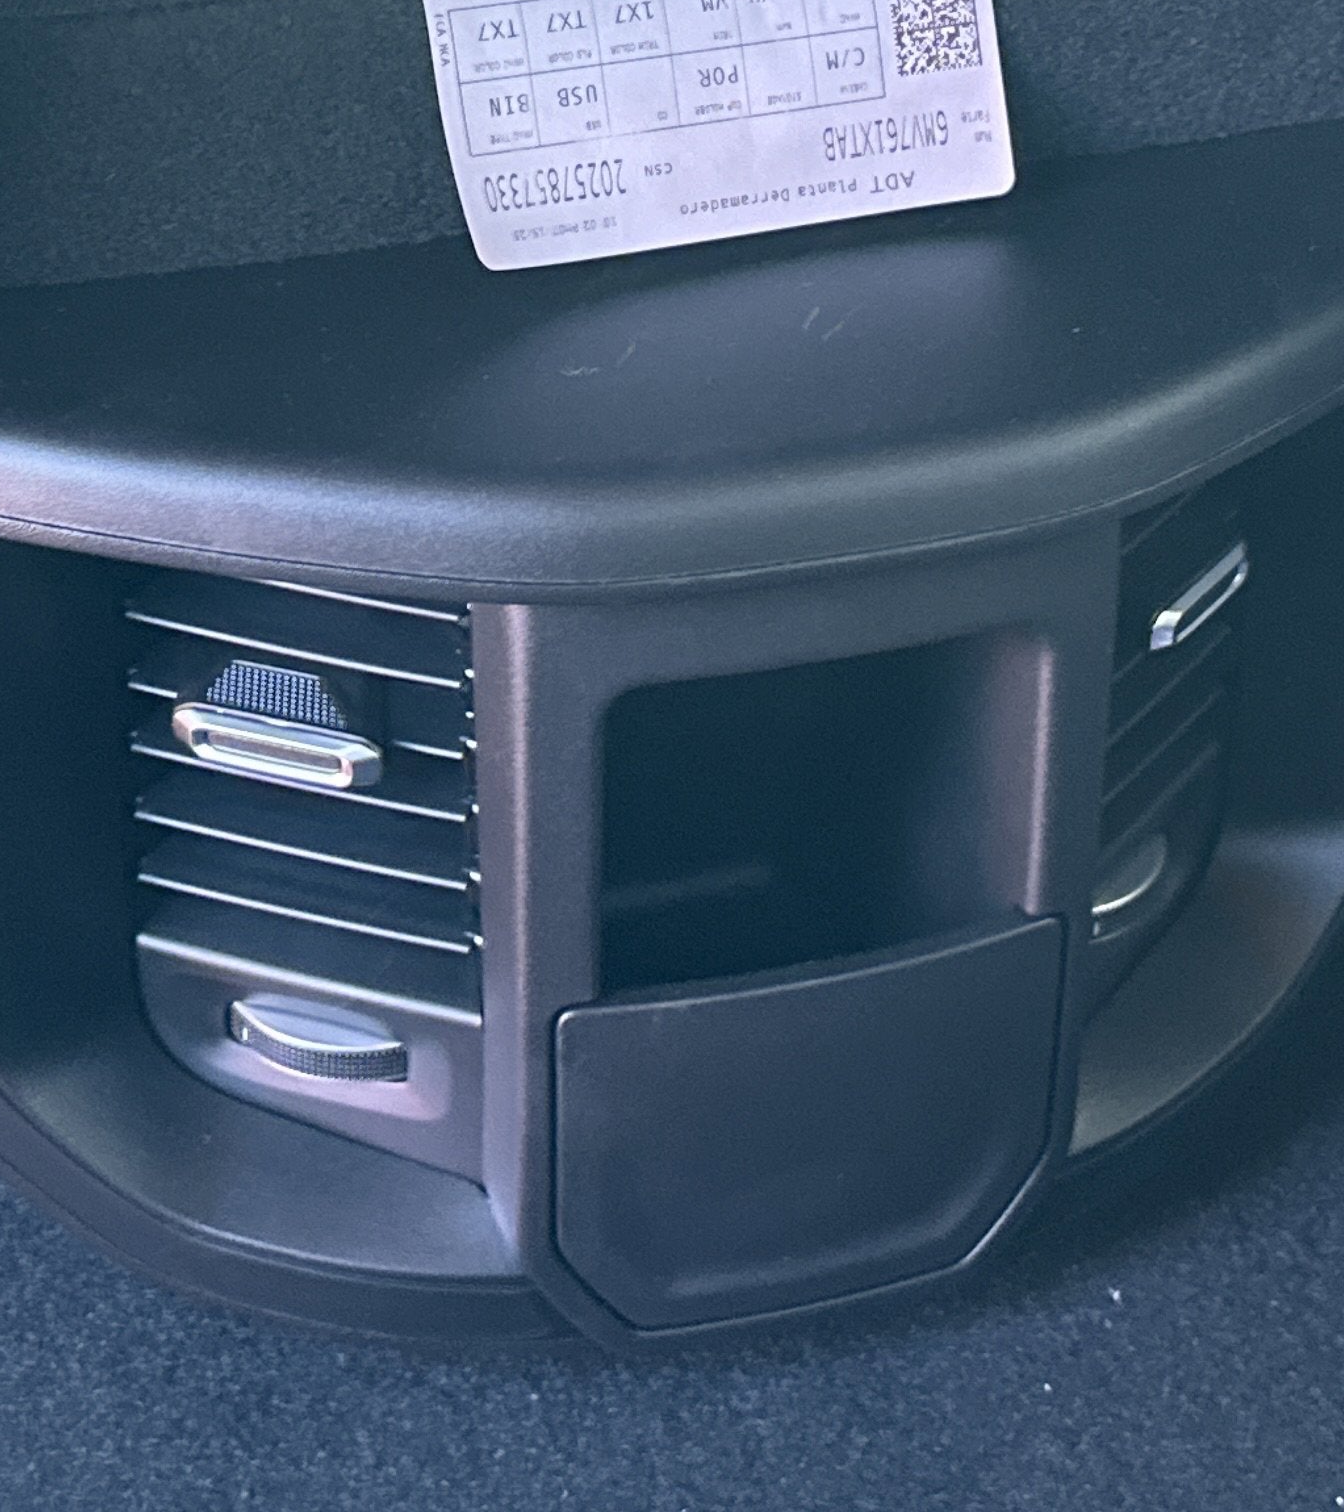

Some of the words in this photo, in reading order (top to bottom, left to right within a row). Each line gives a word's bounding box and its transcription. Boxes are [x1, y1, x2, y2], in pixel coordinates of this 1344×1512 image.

[547, 10, 587, 33] TX7
[615, 1, 654, 24] 1X7
[478, 19, 519, 41] TX7
[826, 47, 865, 70] C/M
[698, 64, 738, 87] POR
[489, 94, 529, 117] BIN
[557, 84, 597, 107] USB
[823, 110, 948, 161] 6MV761XTAB
[644, 163, 672, 176] CSN
[484, 159, 626, 212] 20257857330
[798, 178, 857, 197] Planta
[870, 170, 914, 194] ADT
[680, 188, 790, 216] Derramadero
